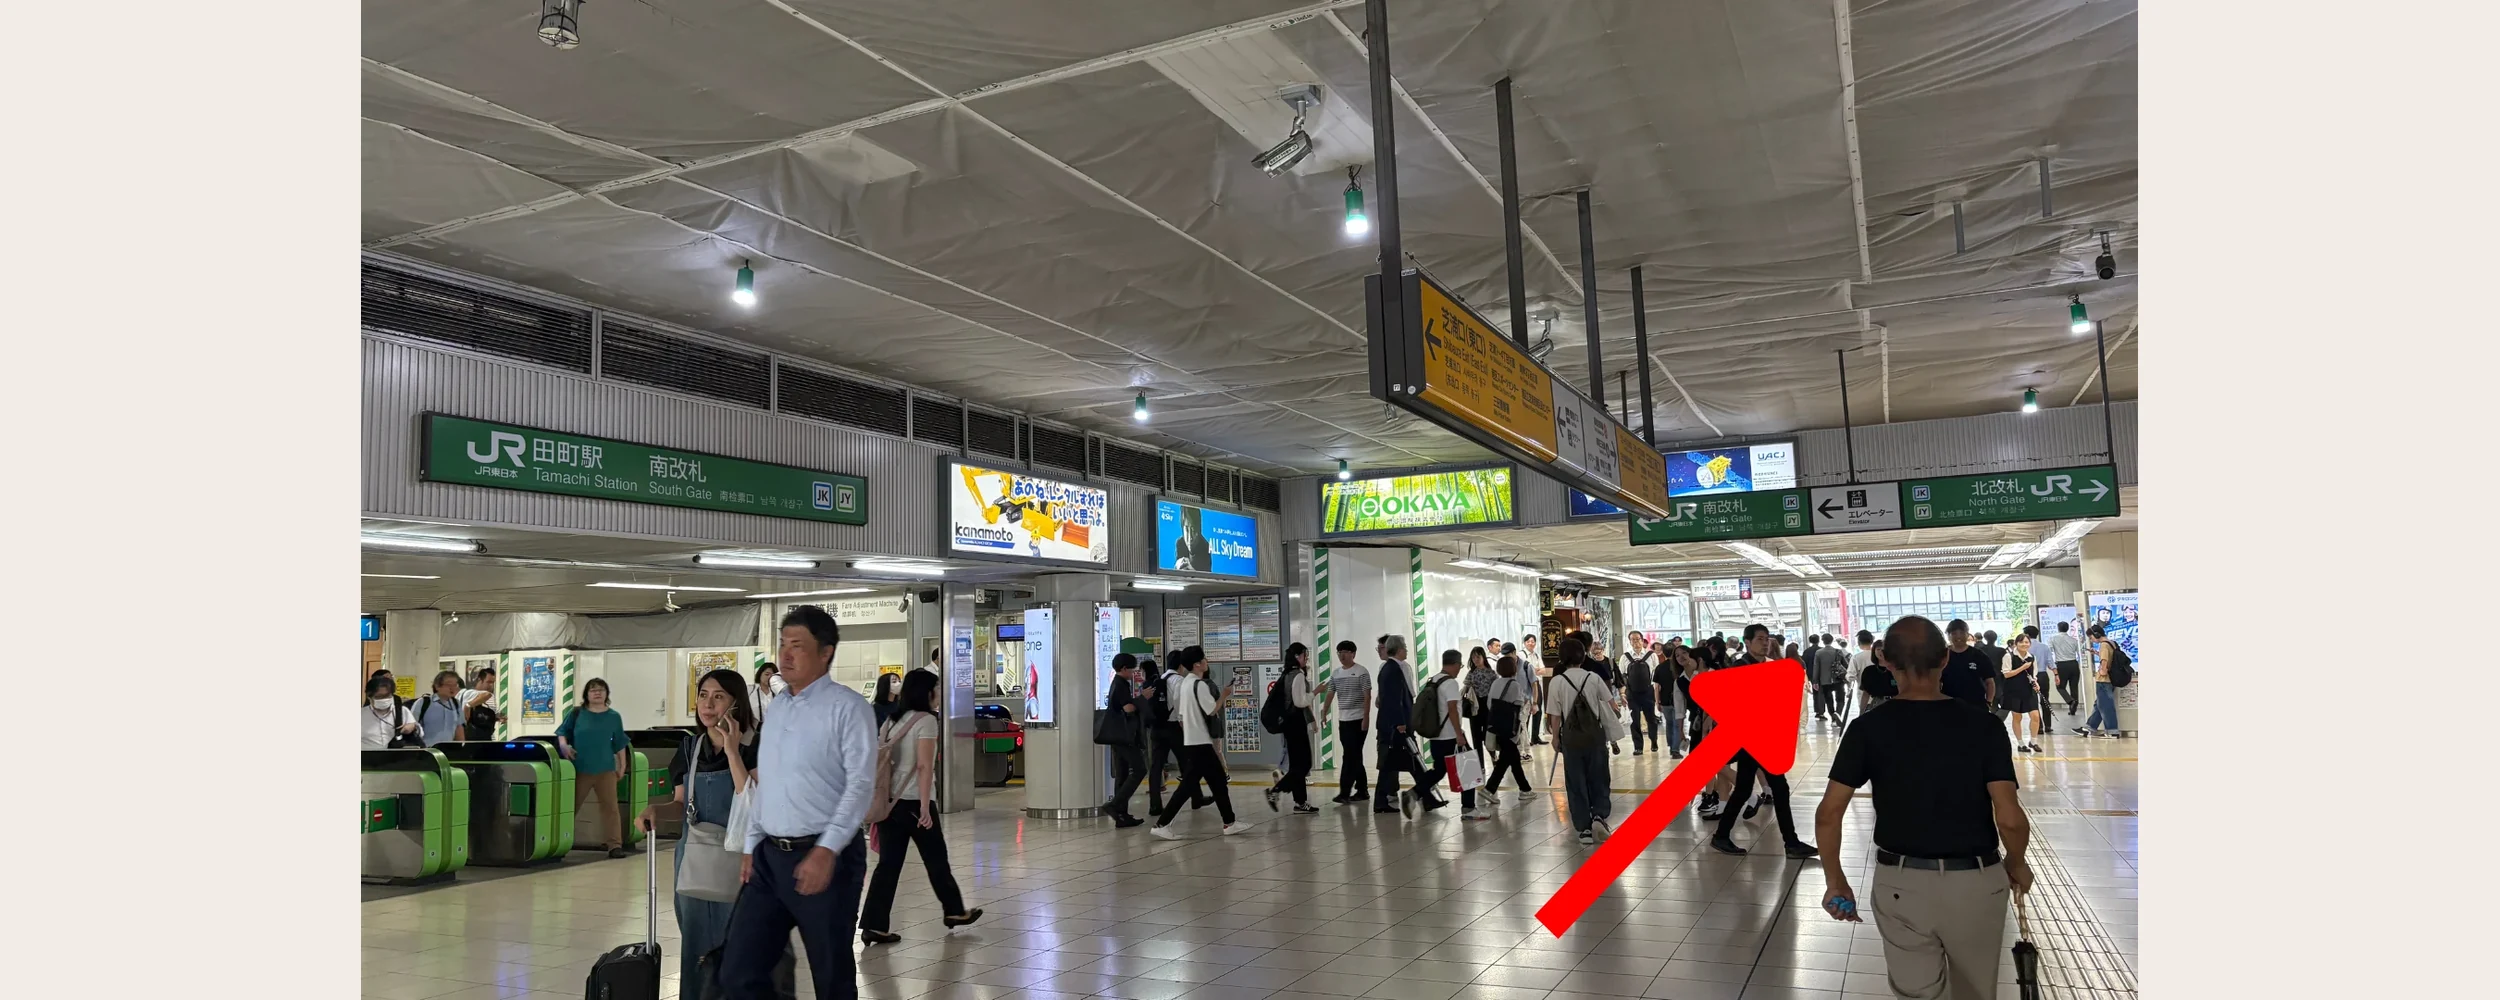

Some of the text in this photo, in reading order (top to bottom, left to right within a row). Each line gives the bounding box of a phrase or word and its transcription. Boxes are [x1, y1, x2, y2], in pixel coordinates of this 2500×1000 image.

[467, 430, 526, 468] JR
[533, 438, 603, 470] 田町駅
[1757, 451, 1786, 461] UACJ
[475, 465, 518, 479] JR東日本
[649, 455, 707, 483] 南改札
[533, 467, 638, 492] Tamachi Station
[1971, 479, 2023, 496] 北改札
[2031, 474, 2073, 495] JR
[649, 481, 712, 501] South Gate
[817, 489, 828, 502] JK
[840, 492, 851, 504] JY
[2038, 495, 2068, 504] JR東日本
[1382, 492, 1471, 515] OKAYA
[1703, 499, 1747, 514] 南改札
[1969, 495, 2025, 507] North Gate
[1665, 503, 1697, 521] JR
[1704, 514, 1752, 525] South Gate
[1848, 509, 1894, 518] エレベーター
[955, 522, 1014, 542] kanamoto
[1208, 538, 1253, 560] ALL Sky Dream
[853, 601, 879, 610] Adjustment
